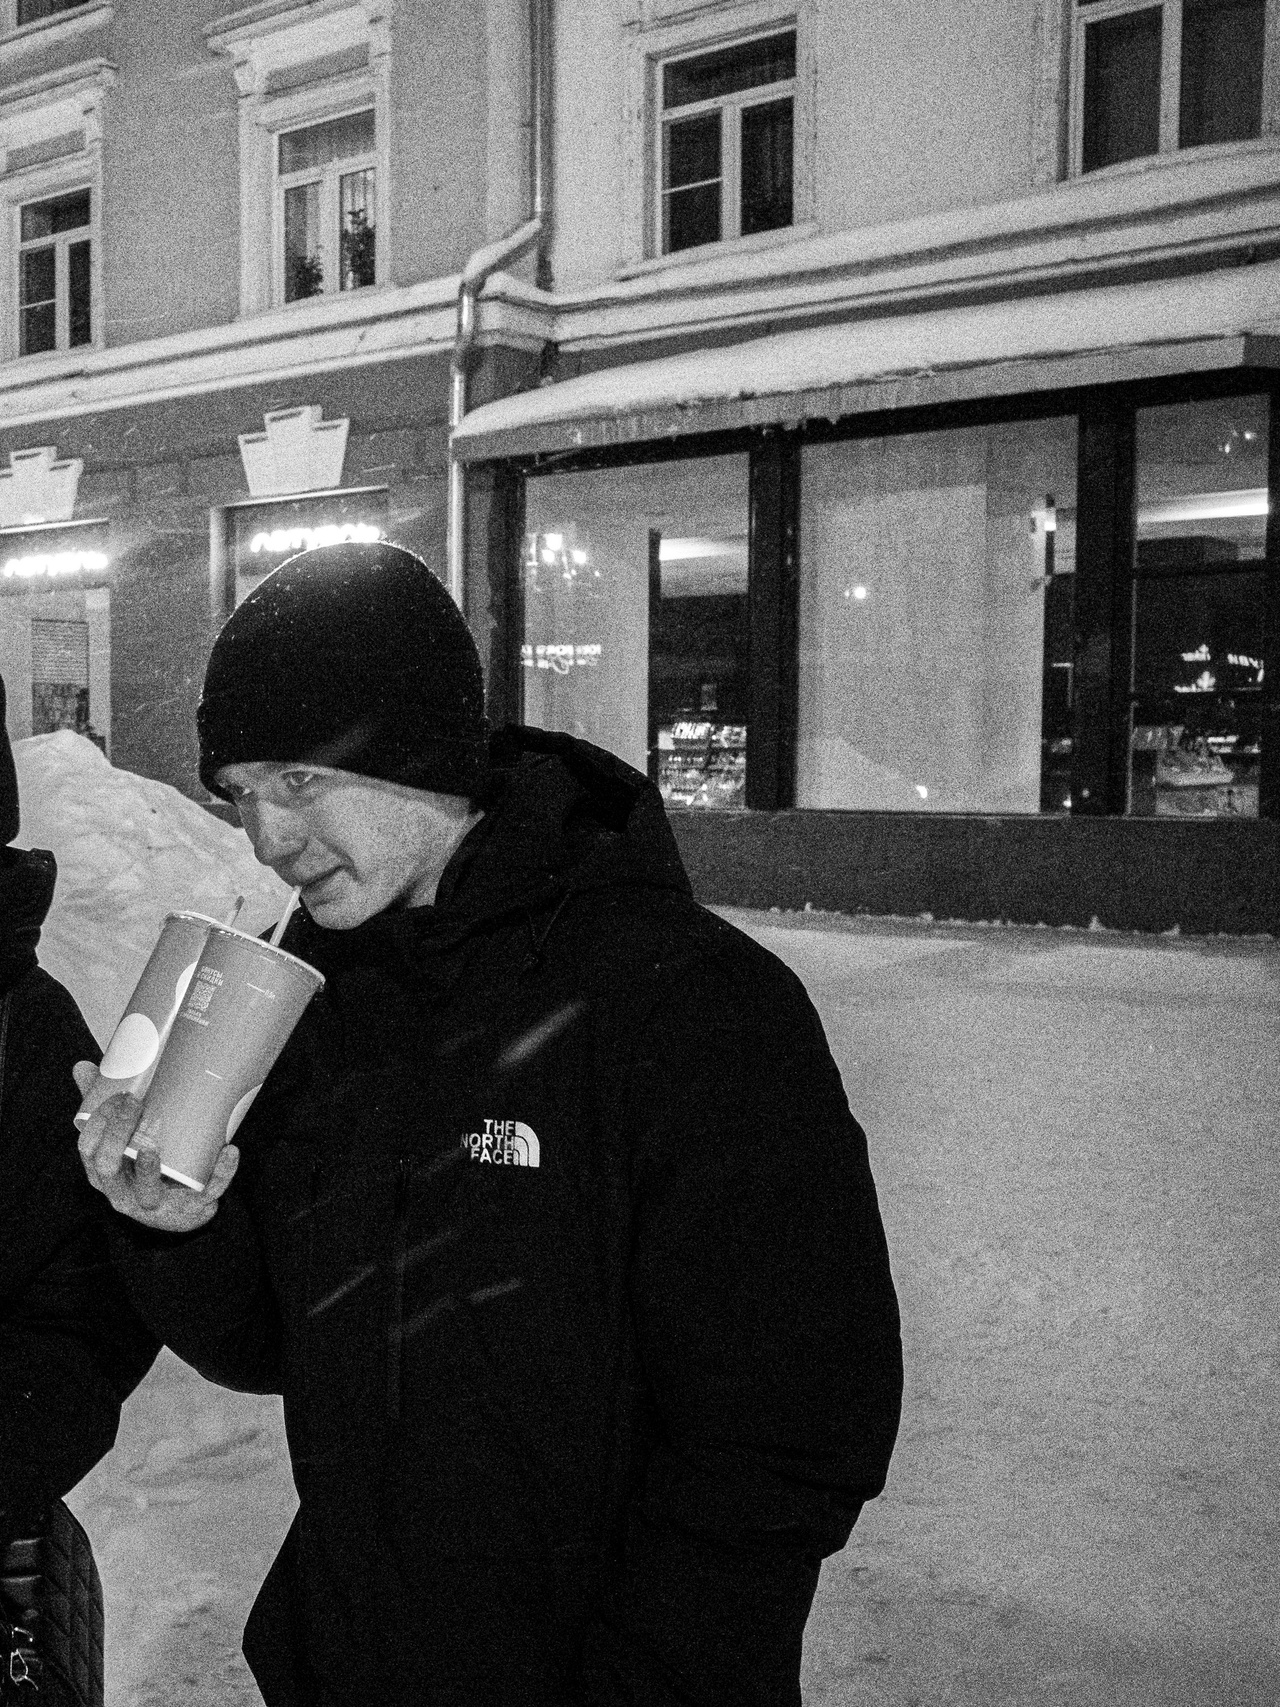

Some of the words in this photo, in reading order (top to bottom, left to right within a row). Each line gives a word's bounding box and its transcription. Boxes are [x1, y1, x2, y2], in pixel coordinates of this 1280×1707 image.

[483, 1118, 515, 1136] THE
[460, 1132, 515, 1150] NORTH
[470, 1147, 513, 1165] FACE
